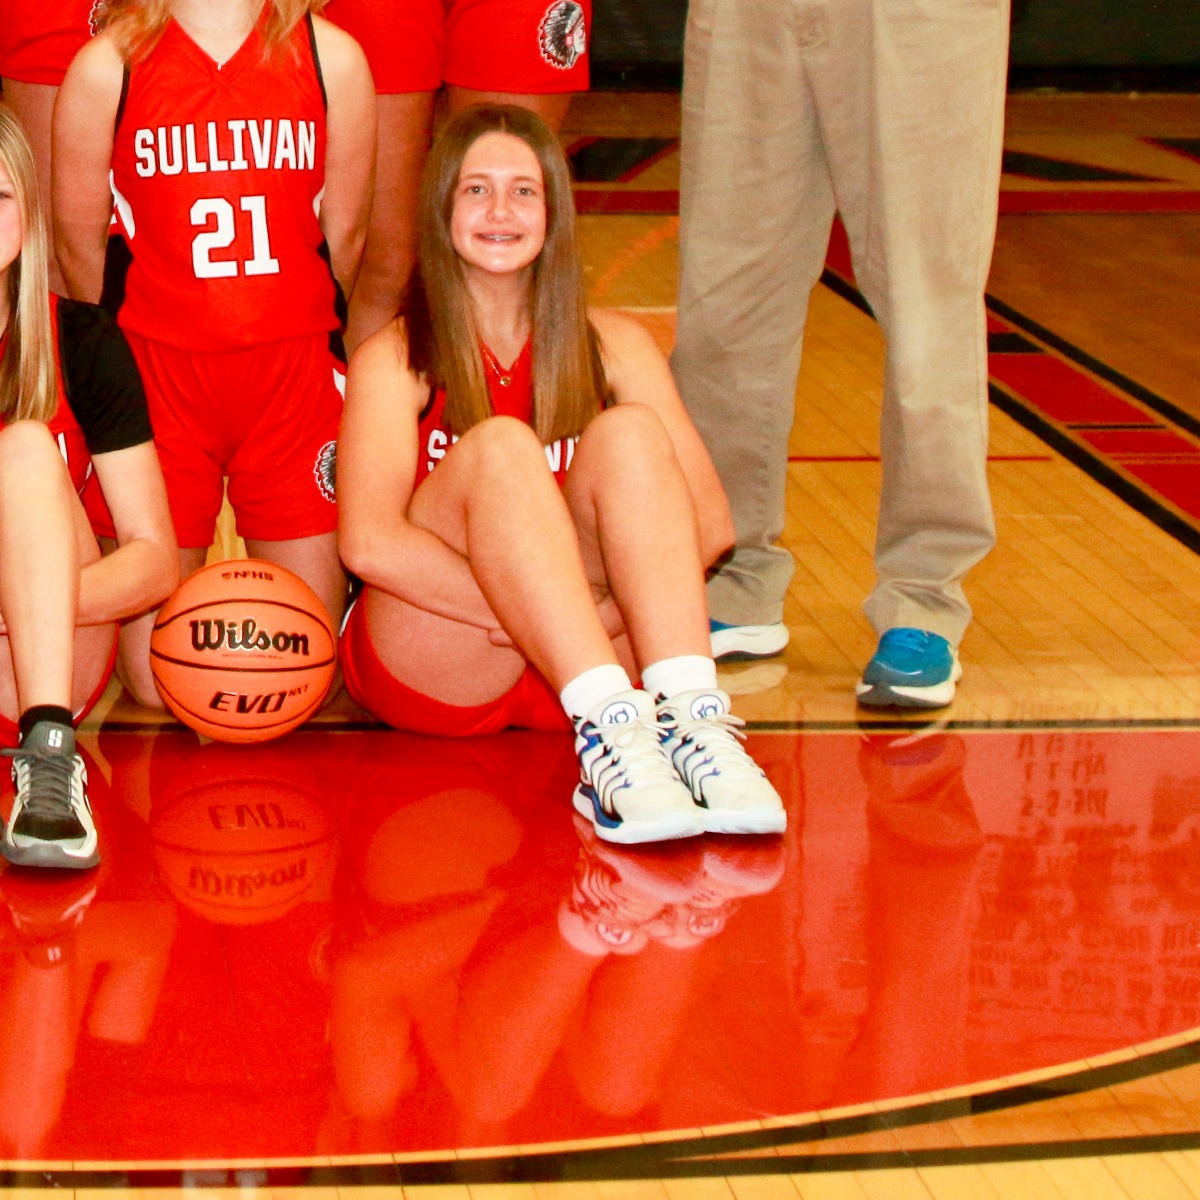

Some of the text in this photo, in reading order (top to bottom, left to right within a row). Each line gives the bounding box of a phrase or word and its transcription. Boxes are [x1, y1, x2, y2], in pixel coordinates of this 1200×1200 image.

[135, 119, 315, 177] SULLIVAN
[190, 195, 280, 278] 21
[189, 617, 310, 656] Wilson
